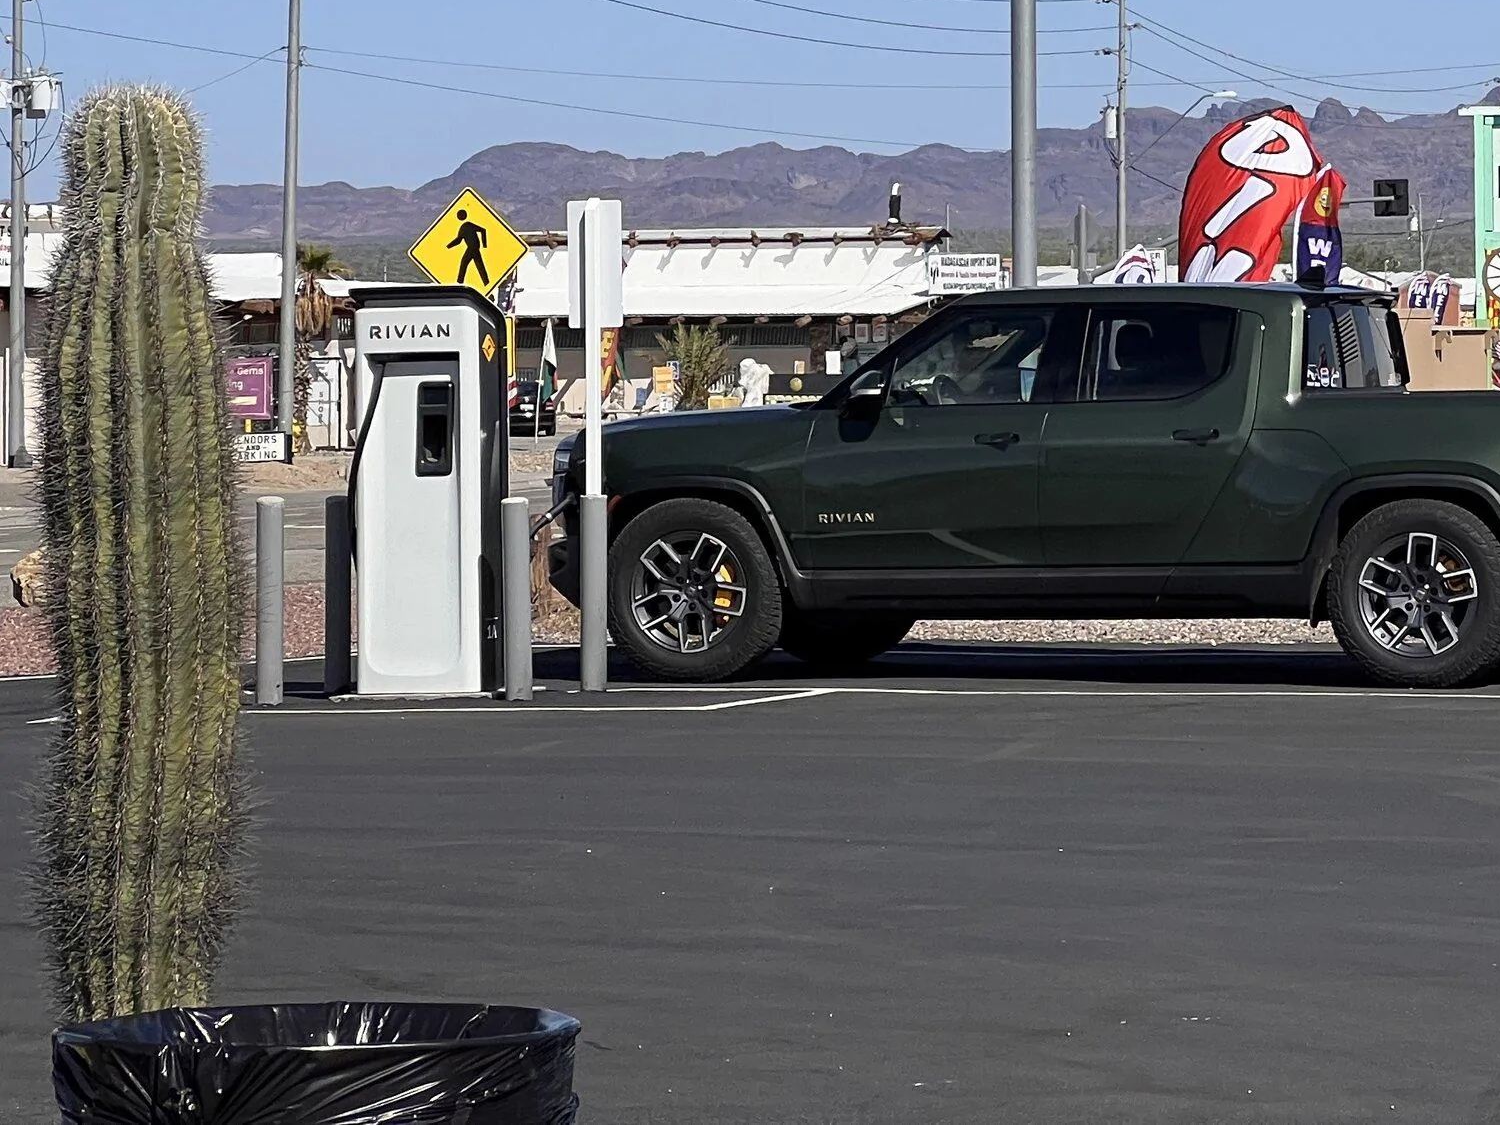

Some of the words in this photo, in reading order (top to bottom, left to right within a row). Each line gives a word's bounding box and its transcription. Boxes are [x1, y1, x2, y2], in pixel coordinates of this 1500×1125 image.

[369, 324, 450, 339] RIVIAN
[237, 367, 264, 376] Gems
[236, 435, 278, 445] ENDORS
[239, 451, 278, 459] ARKING
[818, 512, 875, 524] RIVIAN
